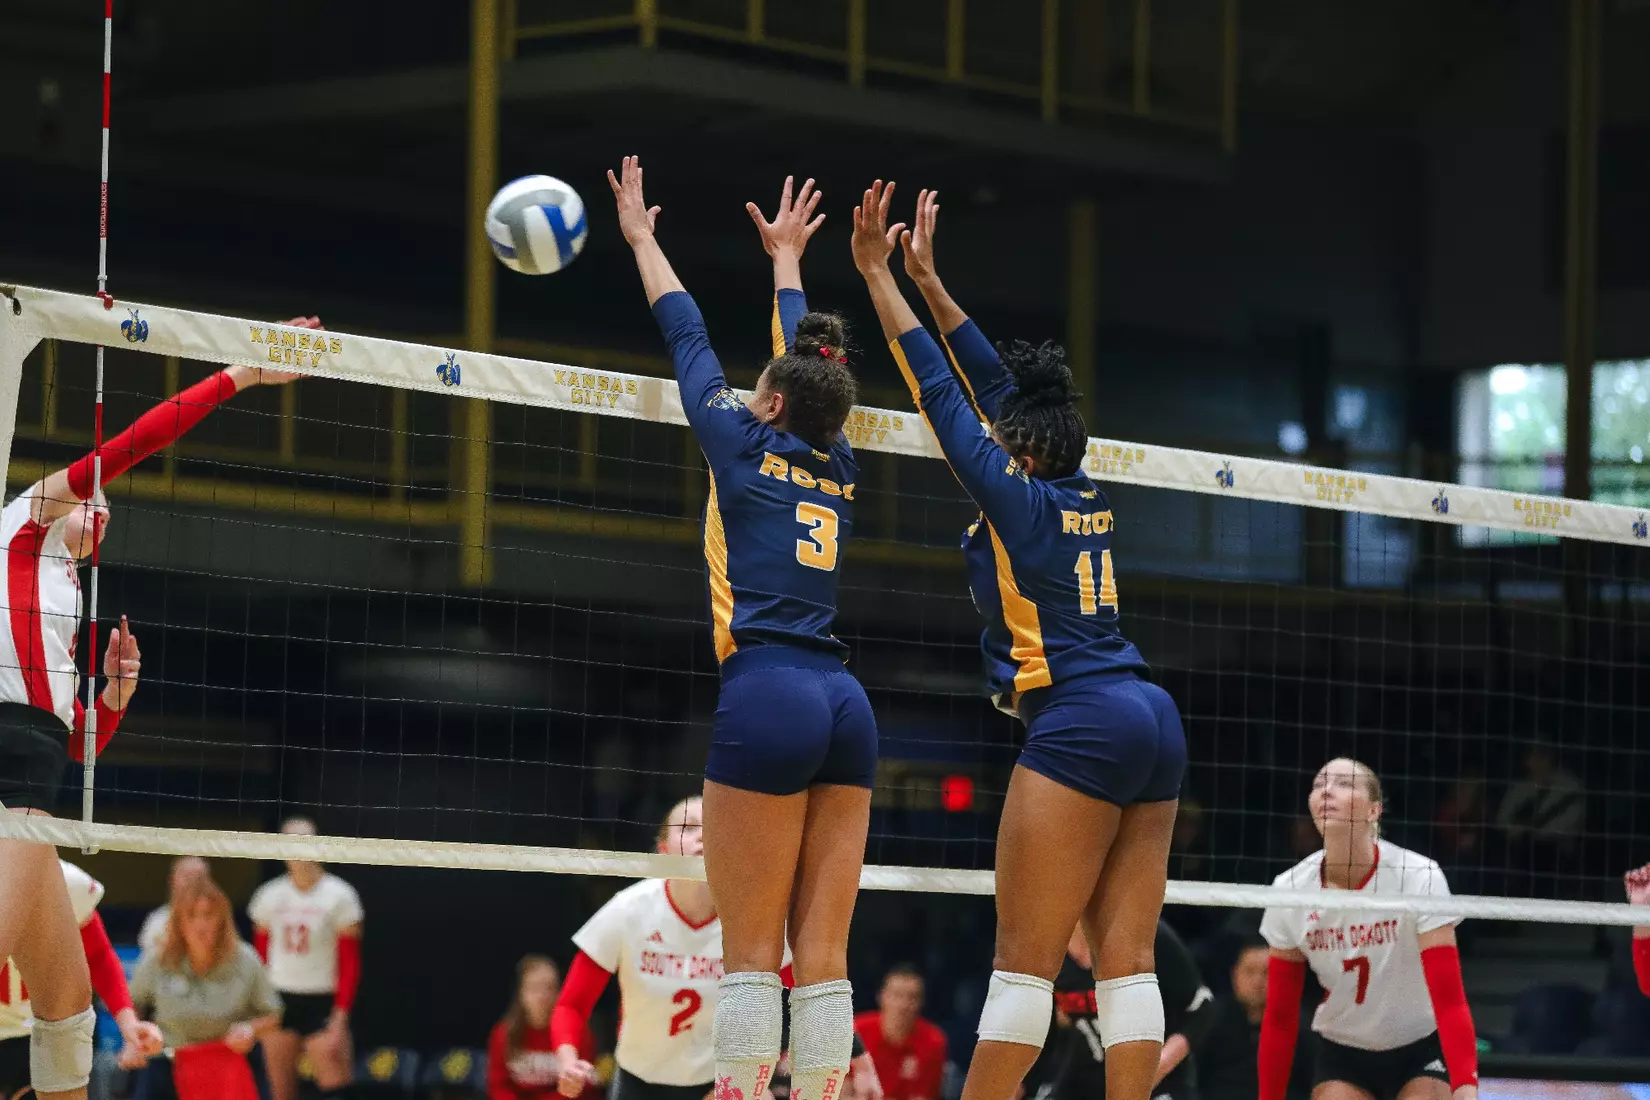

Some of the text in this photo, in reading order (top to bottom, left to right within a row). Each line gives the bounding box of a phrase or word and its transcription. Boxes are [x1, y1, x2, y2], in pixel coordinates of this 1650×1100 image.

[249, 326, 343, 354] KANSAS
[268, 347, 322, 368] CITY
[553, 369, 638, 396] KANSAS
[571, 388, 620, 408] CITY
[843, 425, 888, 444] CITY
[845, 411, 904, 432] ANSAS
[1087, 443, 1145, 464] ANSAS
[1089, 457, 1130, 475] CITY
[796, 501, 839, 572] 3
[1074, 549, 1119, 615] 14
[1305, 924, 1347, 953] SOUTH
[640, 951, 684, 979] SOUTH
[1342, 955, 1370, 1005] 7
[668, 988, 703, 1037] 2
